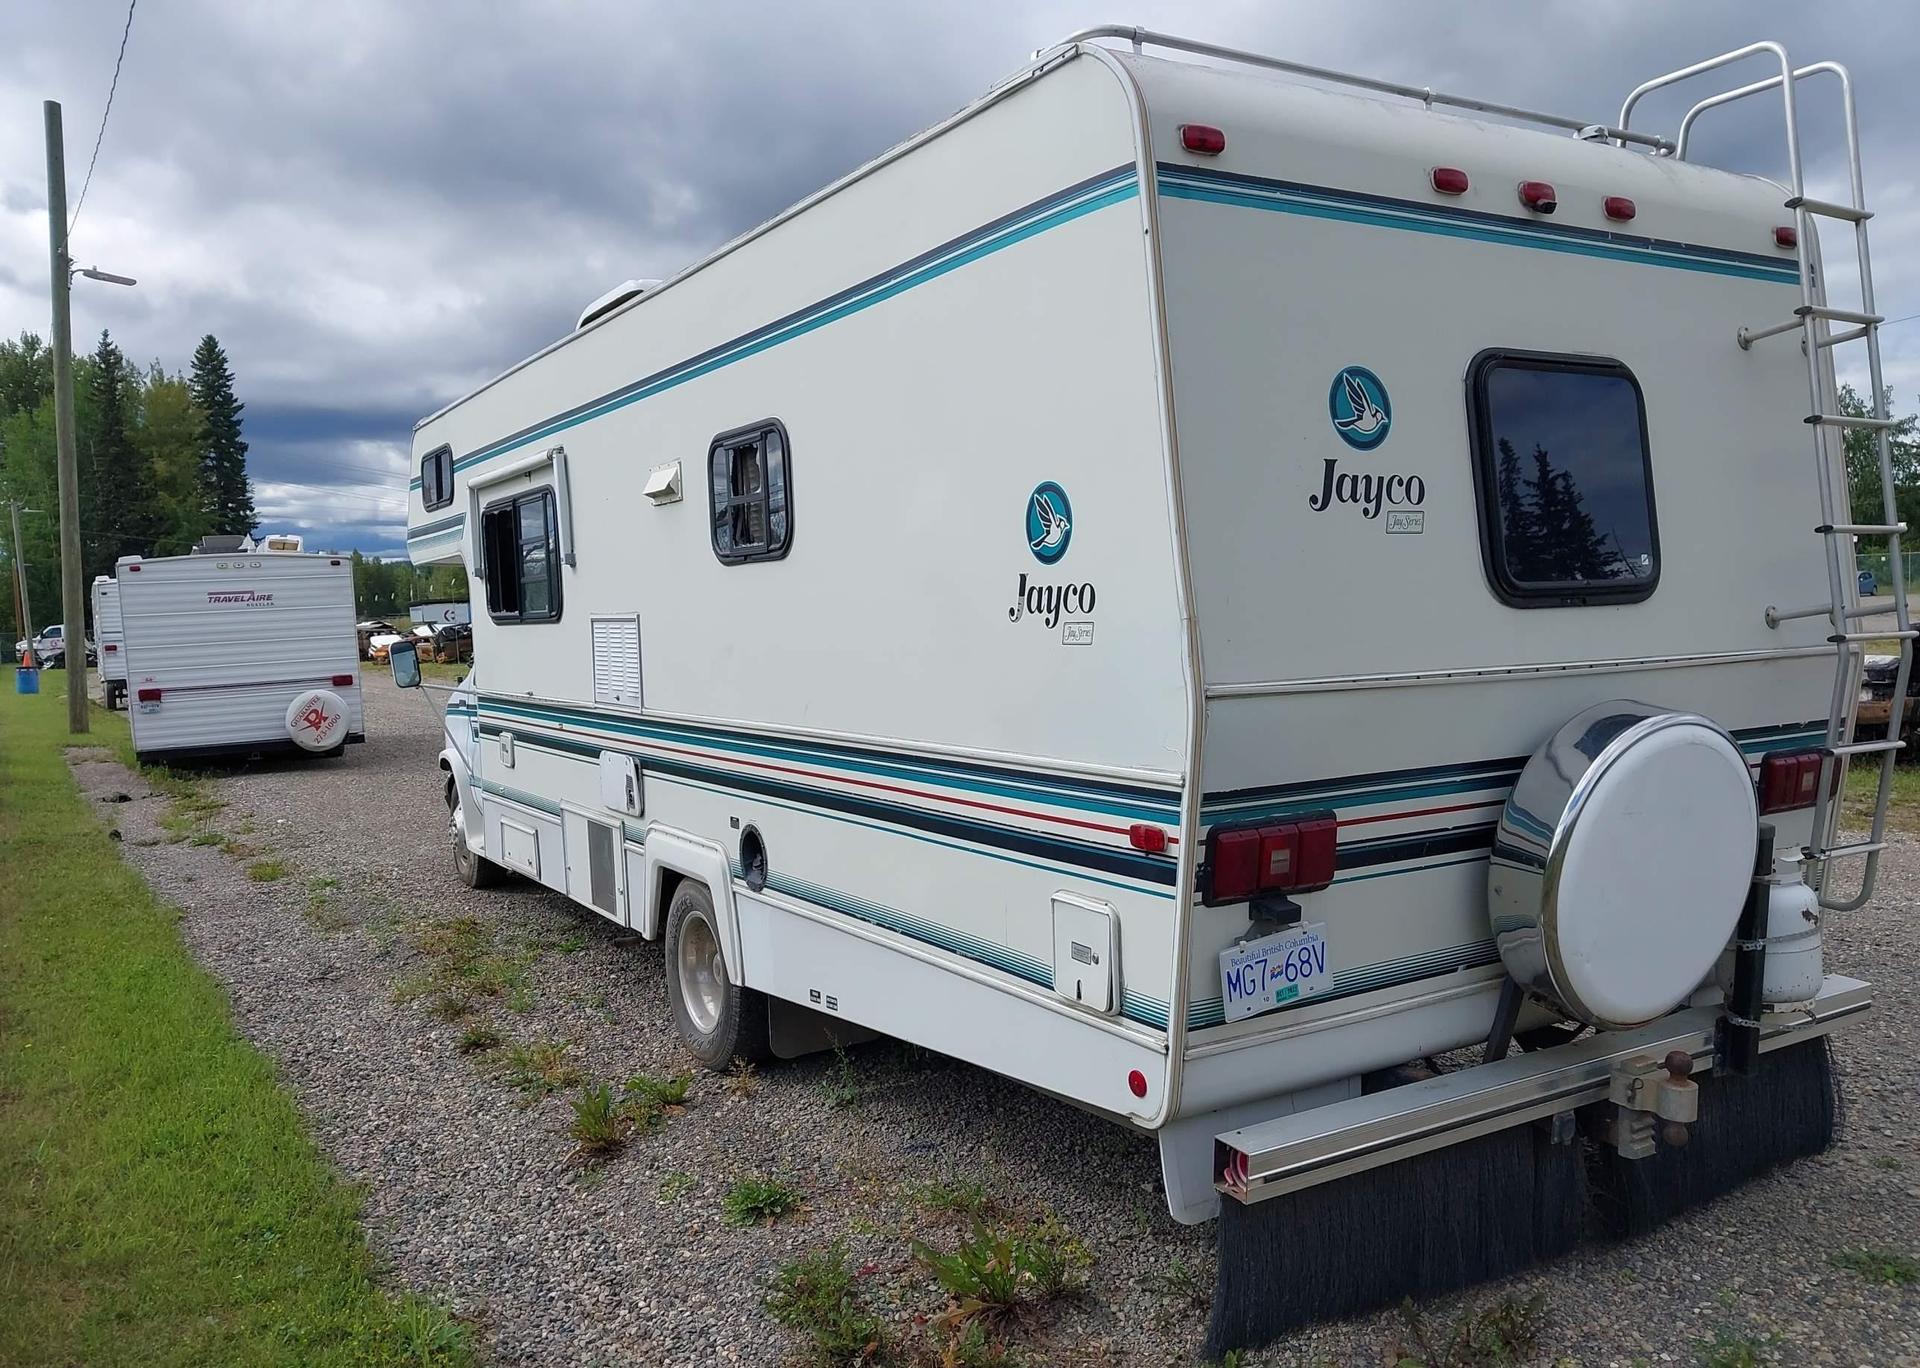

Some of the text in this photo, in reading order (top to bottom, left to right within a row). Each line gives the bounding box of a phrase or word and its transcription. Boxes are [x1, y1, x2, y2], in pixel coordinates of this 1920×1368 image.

[1309, 458, 1425, 519] Jayco
[1008, 573, 1096, 629] Jayco
[1231, 933, 1319, 968] Beautiful British Columbia
